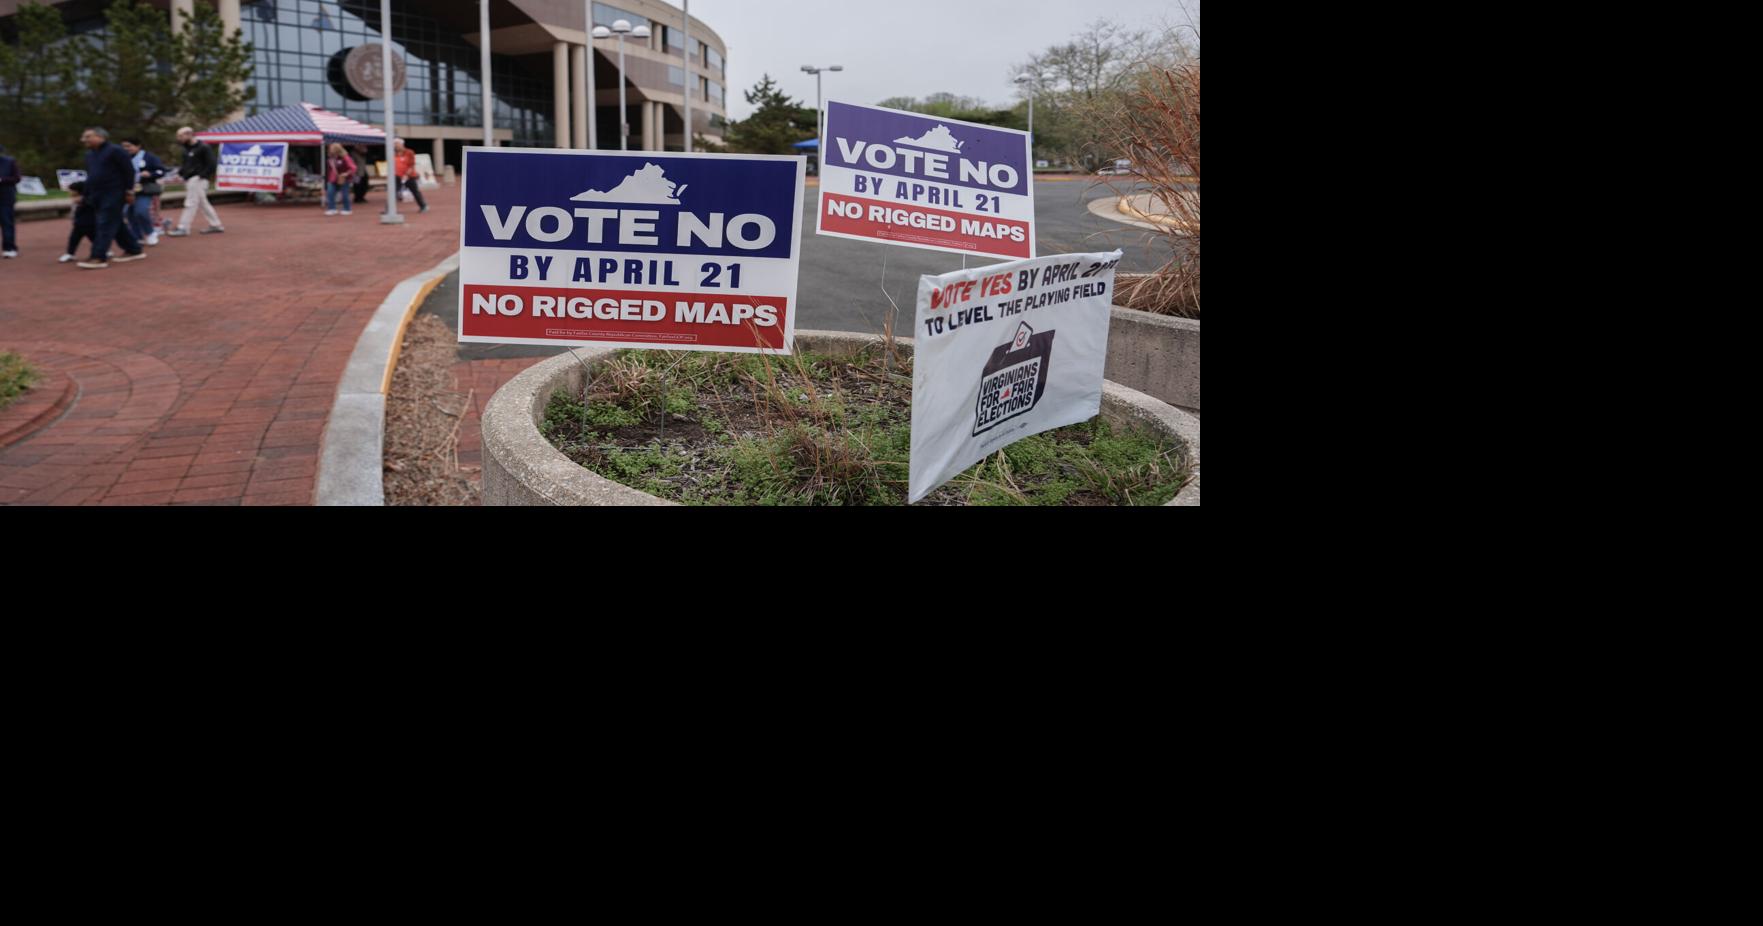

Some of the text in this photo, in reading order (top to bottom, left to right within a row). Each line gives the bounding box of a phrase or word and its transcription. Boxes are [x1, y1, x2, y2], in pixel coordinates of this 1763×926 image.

[222, 154, 280, 168] VOTE NO
[836, 137, 1018, 189] VOTE NO
[854, 174, 1000, 214] BY APRIL 21
[480, 204, 776, 250] VOTE NO
[828, 199, 863, 219] NO
[868, 204, 956, 232] RIGGED
[961, 218, 1025, 242] MAPS
[510, 254, 741, 288] BY APRIL 21
[930, 280, 977, 310] VOTE
[981, 272, 1013, 298] YES
[1018, 268, 1039, 291] BY
[1042, 262, 1080, 286] APRIL
[472, 293, 778, 327] NO RIGGED MAPS
[925, 282, 1106, 336] TO LEVEL THE PLAYING FIELD
[980, 377, 1034, 412] FOR FAIR
[983, 362, 1038, 396] VIRGINIANS
[978, 391, 1032, 427] ELECTIONS
